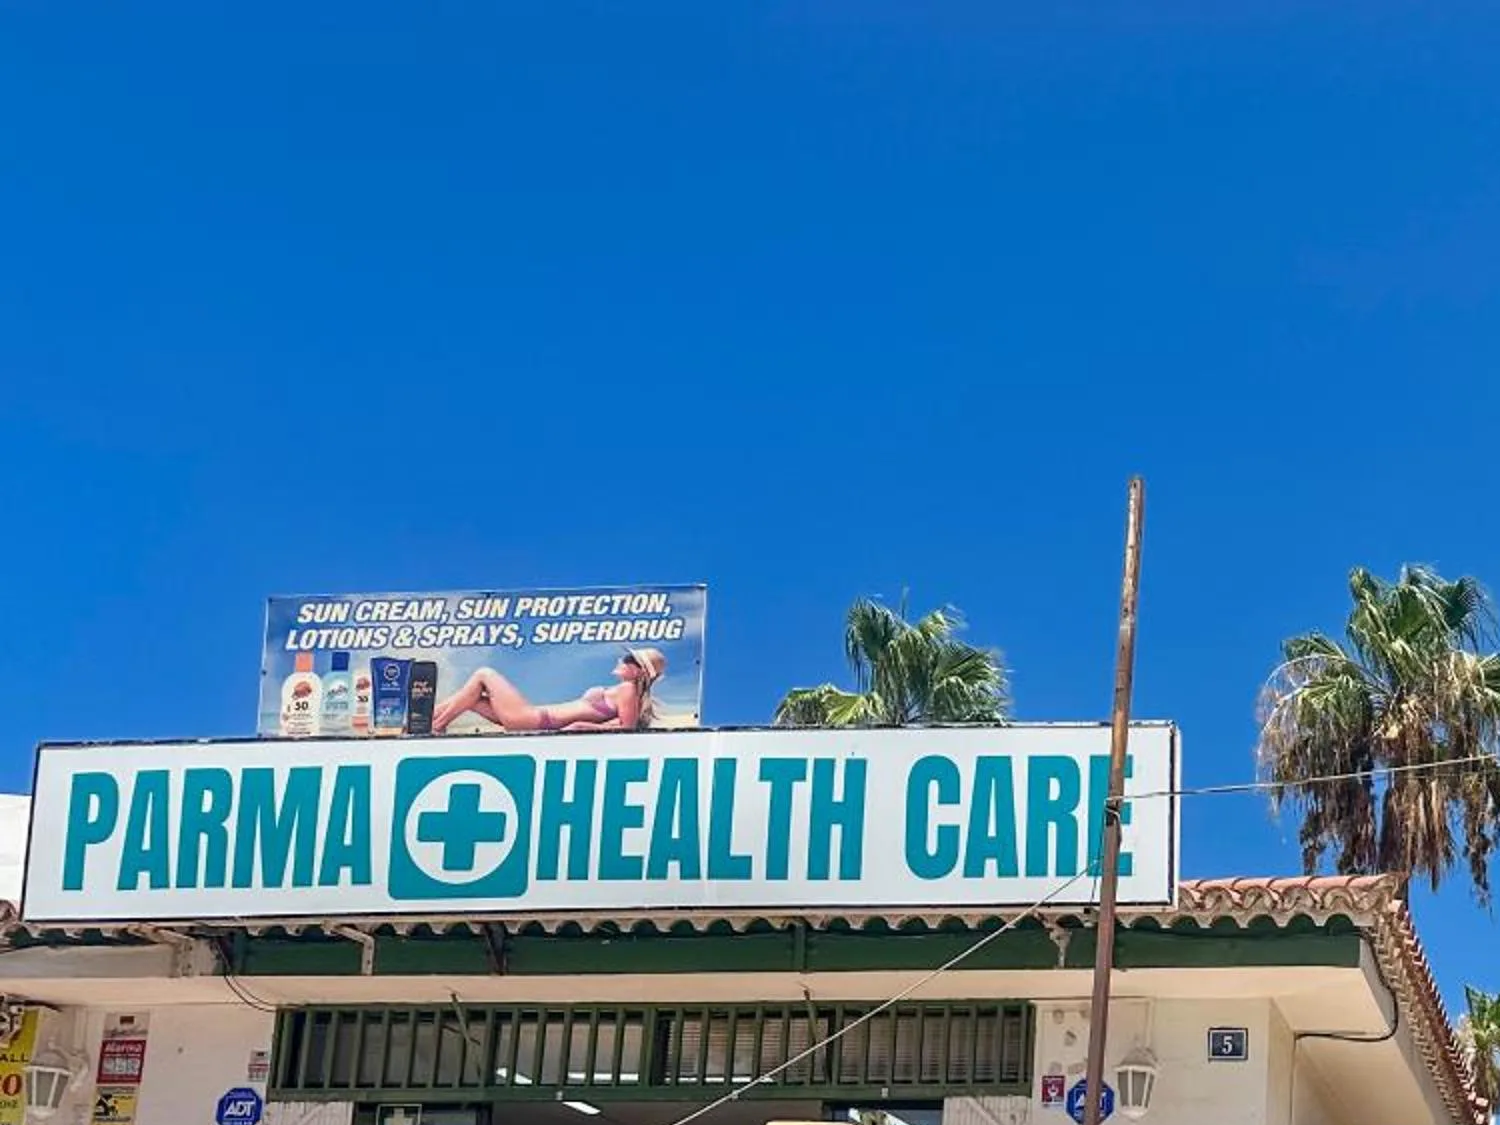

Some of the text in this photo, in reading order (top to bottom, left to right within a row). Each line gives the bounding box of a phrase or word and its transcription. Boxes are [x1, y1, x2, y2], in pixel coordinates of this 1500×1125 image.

[297, 593, 672, 624] SUN CREAM, SUN PROTECTION,
[285, 619, 684, 650] LOTIONS & SPRAYS, SUPERDRUG
[62, 754, 1134, 891] PARMA HEALTH CARE
[1222, 1035, 1233, 1055] 5
[224, 1101, 257, 1117] ADT
